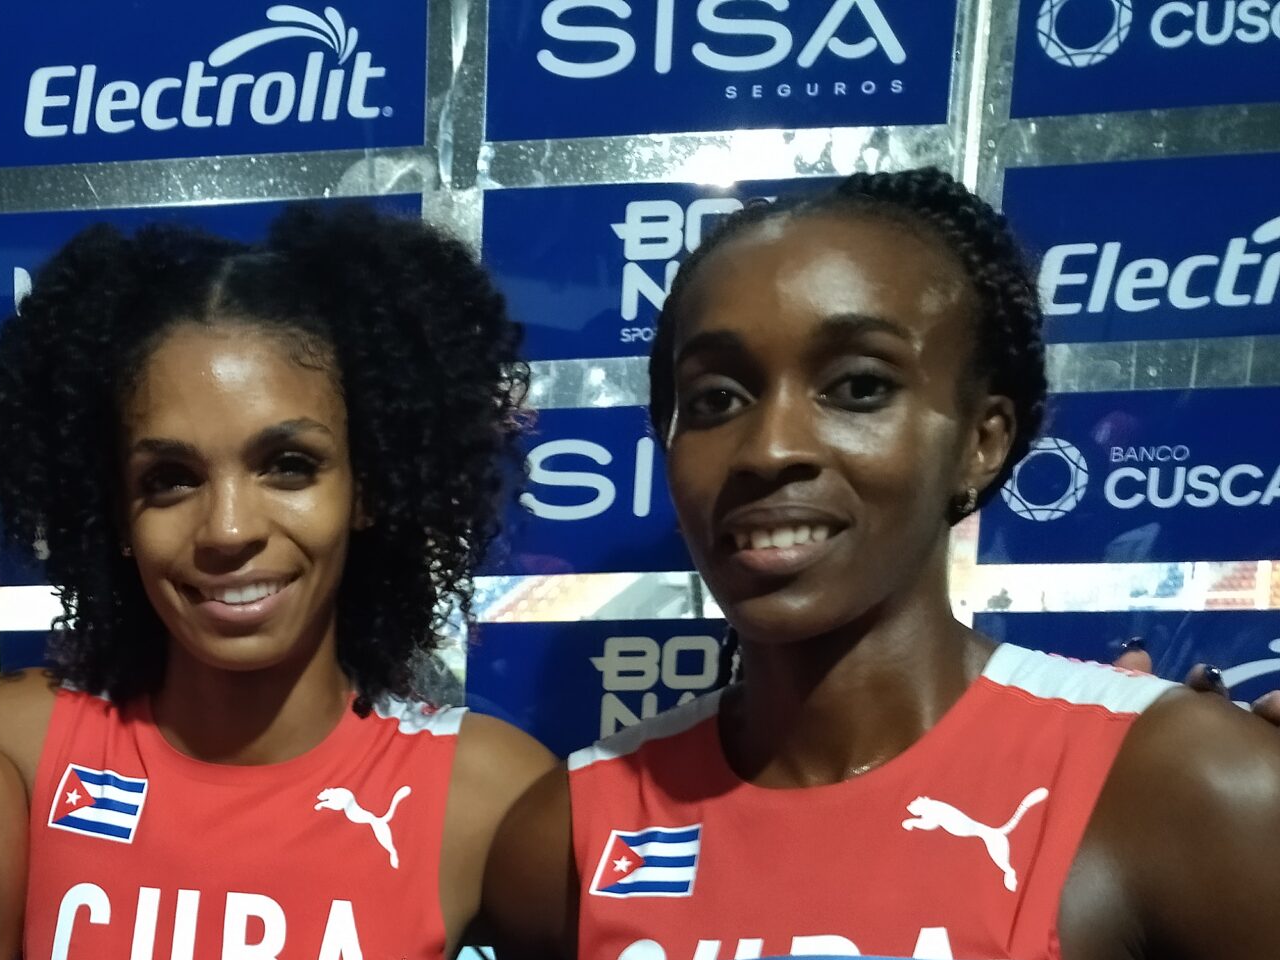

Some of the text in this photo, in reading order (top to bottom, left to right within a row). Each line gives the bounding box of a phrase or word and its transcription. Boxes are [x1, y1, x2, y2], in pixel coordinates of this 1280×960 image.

[537, 0, 906, 79] SISA
[1150, 0, 1280, 48] CUS
[24, 50, 386, 137] Electrolit
[725, 80, 903, 99] SEGUROS
[621, 328, 657, 342] SPO
[1110, 445, 1190, 463] BANCO
